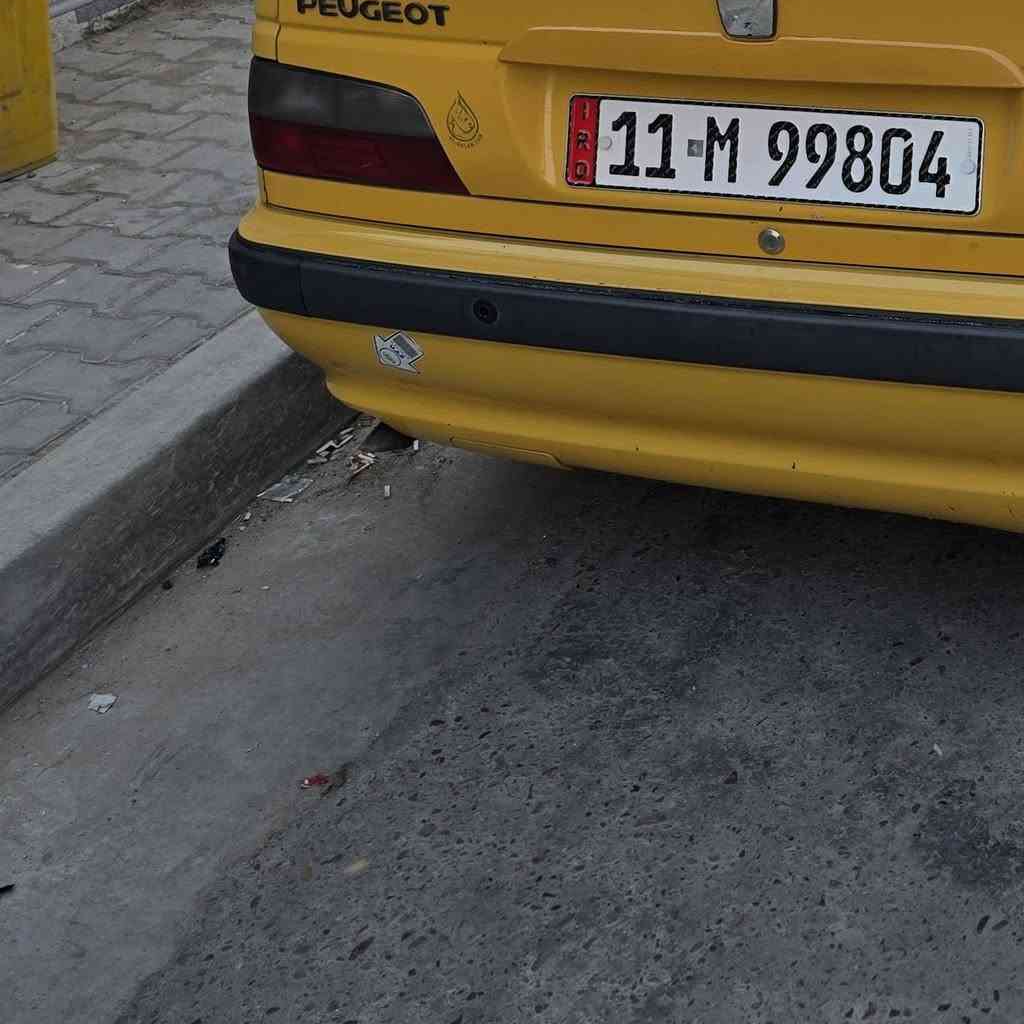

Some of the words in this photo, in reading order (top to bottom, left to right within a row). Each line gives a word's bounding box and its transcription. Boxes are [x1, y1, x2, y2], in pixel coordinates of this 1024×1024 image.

[608, 110, 677, 180] 11
[703, 115, 740, 184] M
[767, 120, 952, 199] 99804
